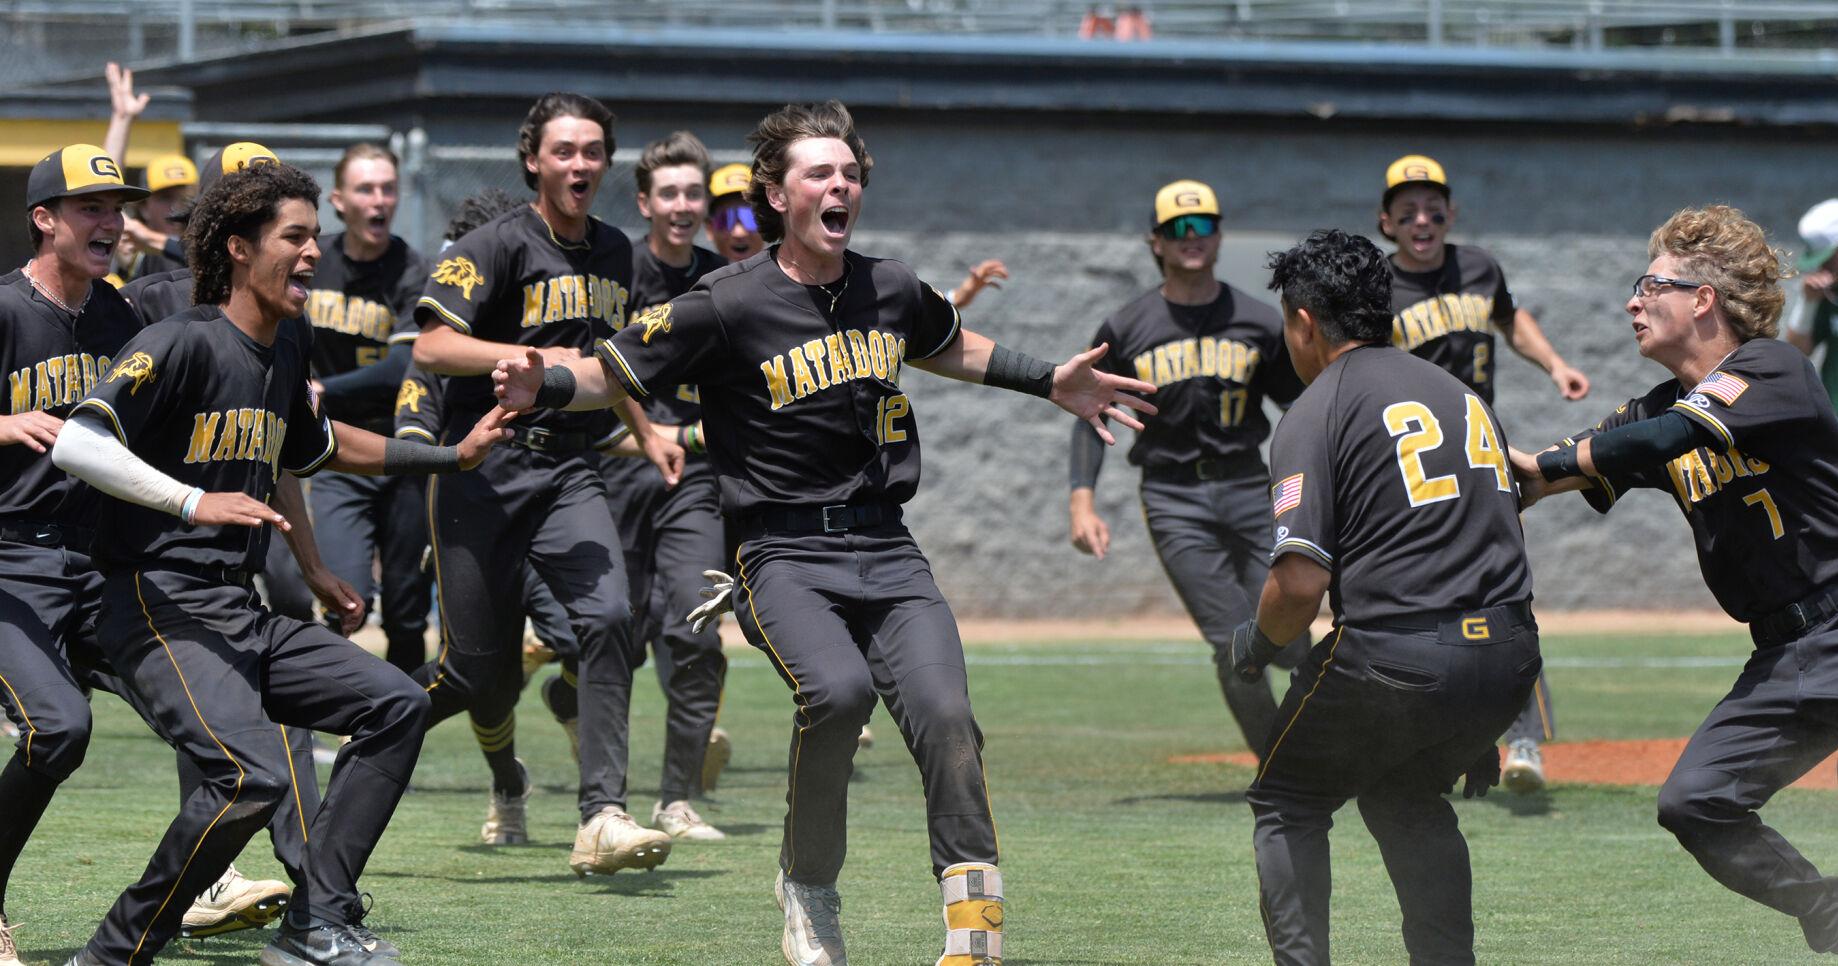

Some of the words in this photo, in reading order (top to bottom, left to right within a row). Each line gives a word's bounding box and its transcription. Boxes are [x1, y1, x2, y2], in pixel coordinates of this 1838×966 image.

[90, 156, 120, 179] G
[1405, 165, 1428, 181] G
[1175, 192, 1202, 208] G
[1473, 342, 1489, 383] 2
[876, 393, 909, 445] 12
[1220, 389, 1249, 427] 17
[1382, 393, 1511, 508] 24
[1742, 488, 1785, 540] 7
[1462, 617, 1490, 639] G
